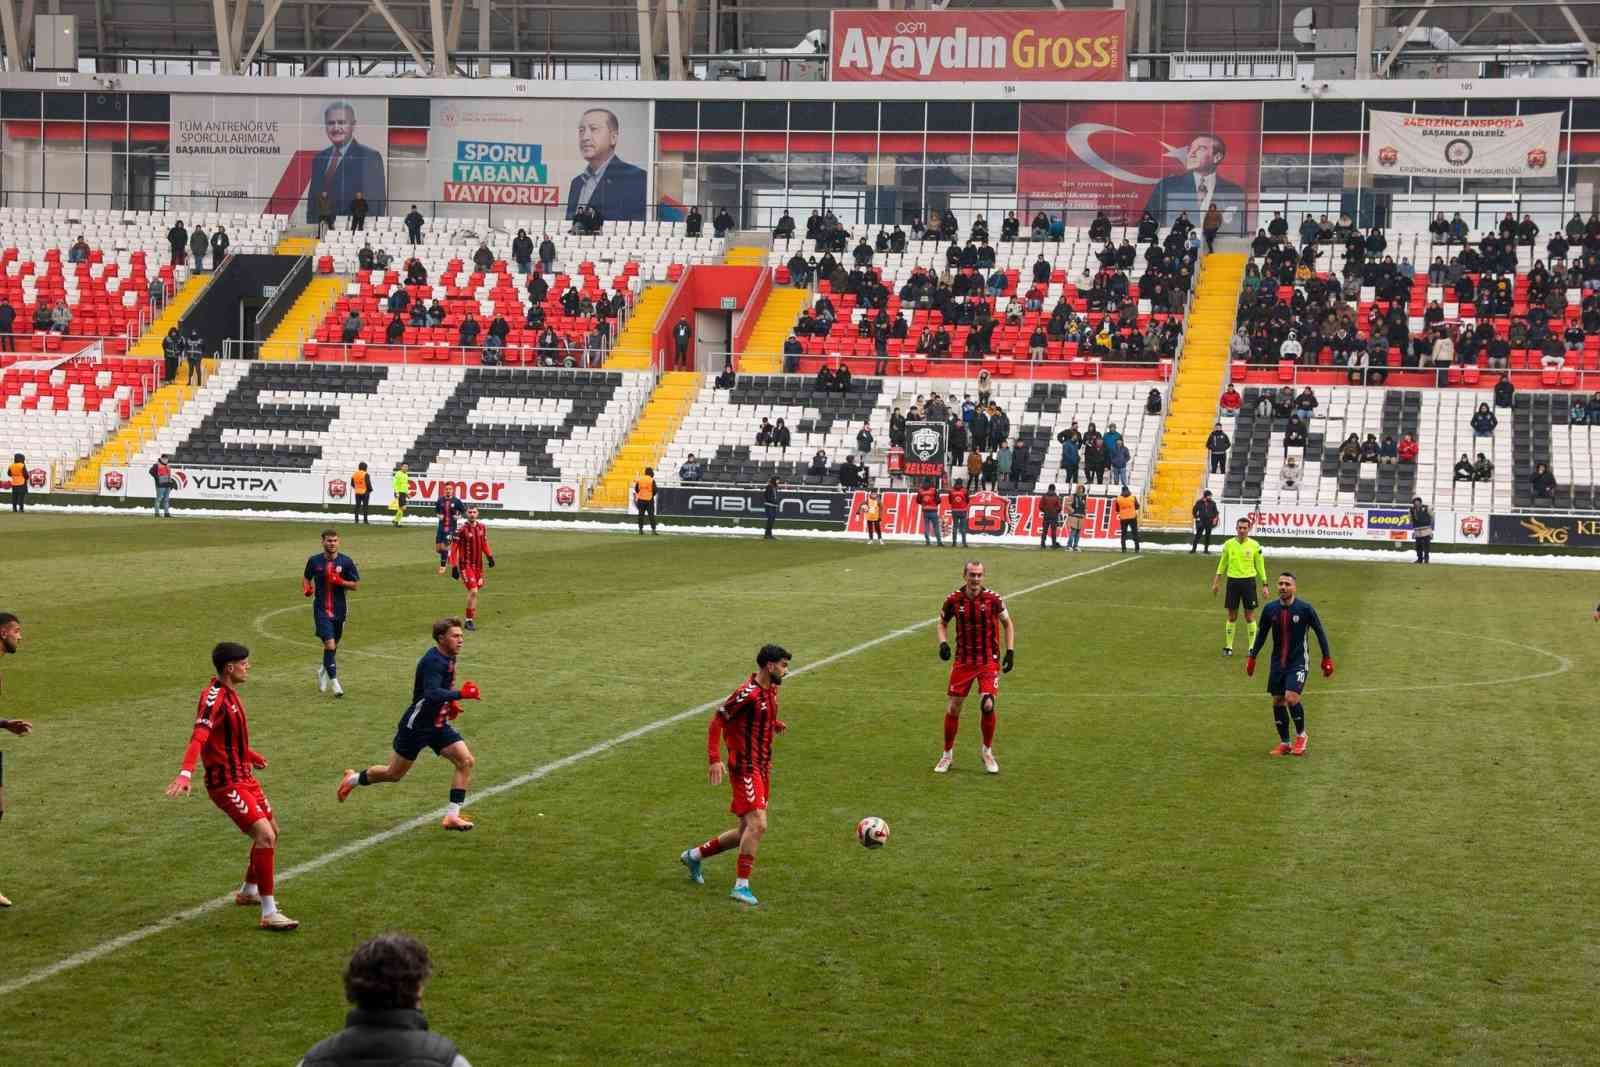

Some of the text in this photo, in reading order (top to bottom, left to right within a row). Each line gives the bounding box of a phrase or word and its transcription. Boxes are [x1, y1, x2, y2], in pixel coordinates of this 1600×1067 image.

[839, 27, 1111, 76] Ayaydın Gross
[180, 120, 279, 132] TÜM ANTRENÖR VE
[182, 132, 275, 143] SPORCULARIMIZA
[176, 145, 280, 156] BAŞARILAR DİLİYORUM
[464, 143, 531, 163] SPORU
[459, 164, 540, 183] TABANA
[447, 184, 557, 205] YAYIYORUZ
[192, 475, 279, 492] YURTPA
[688, 495, 831, 515] FIBLNE
